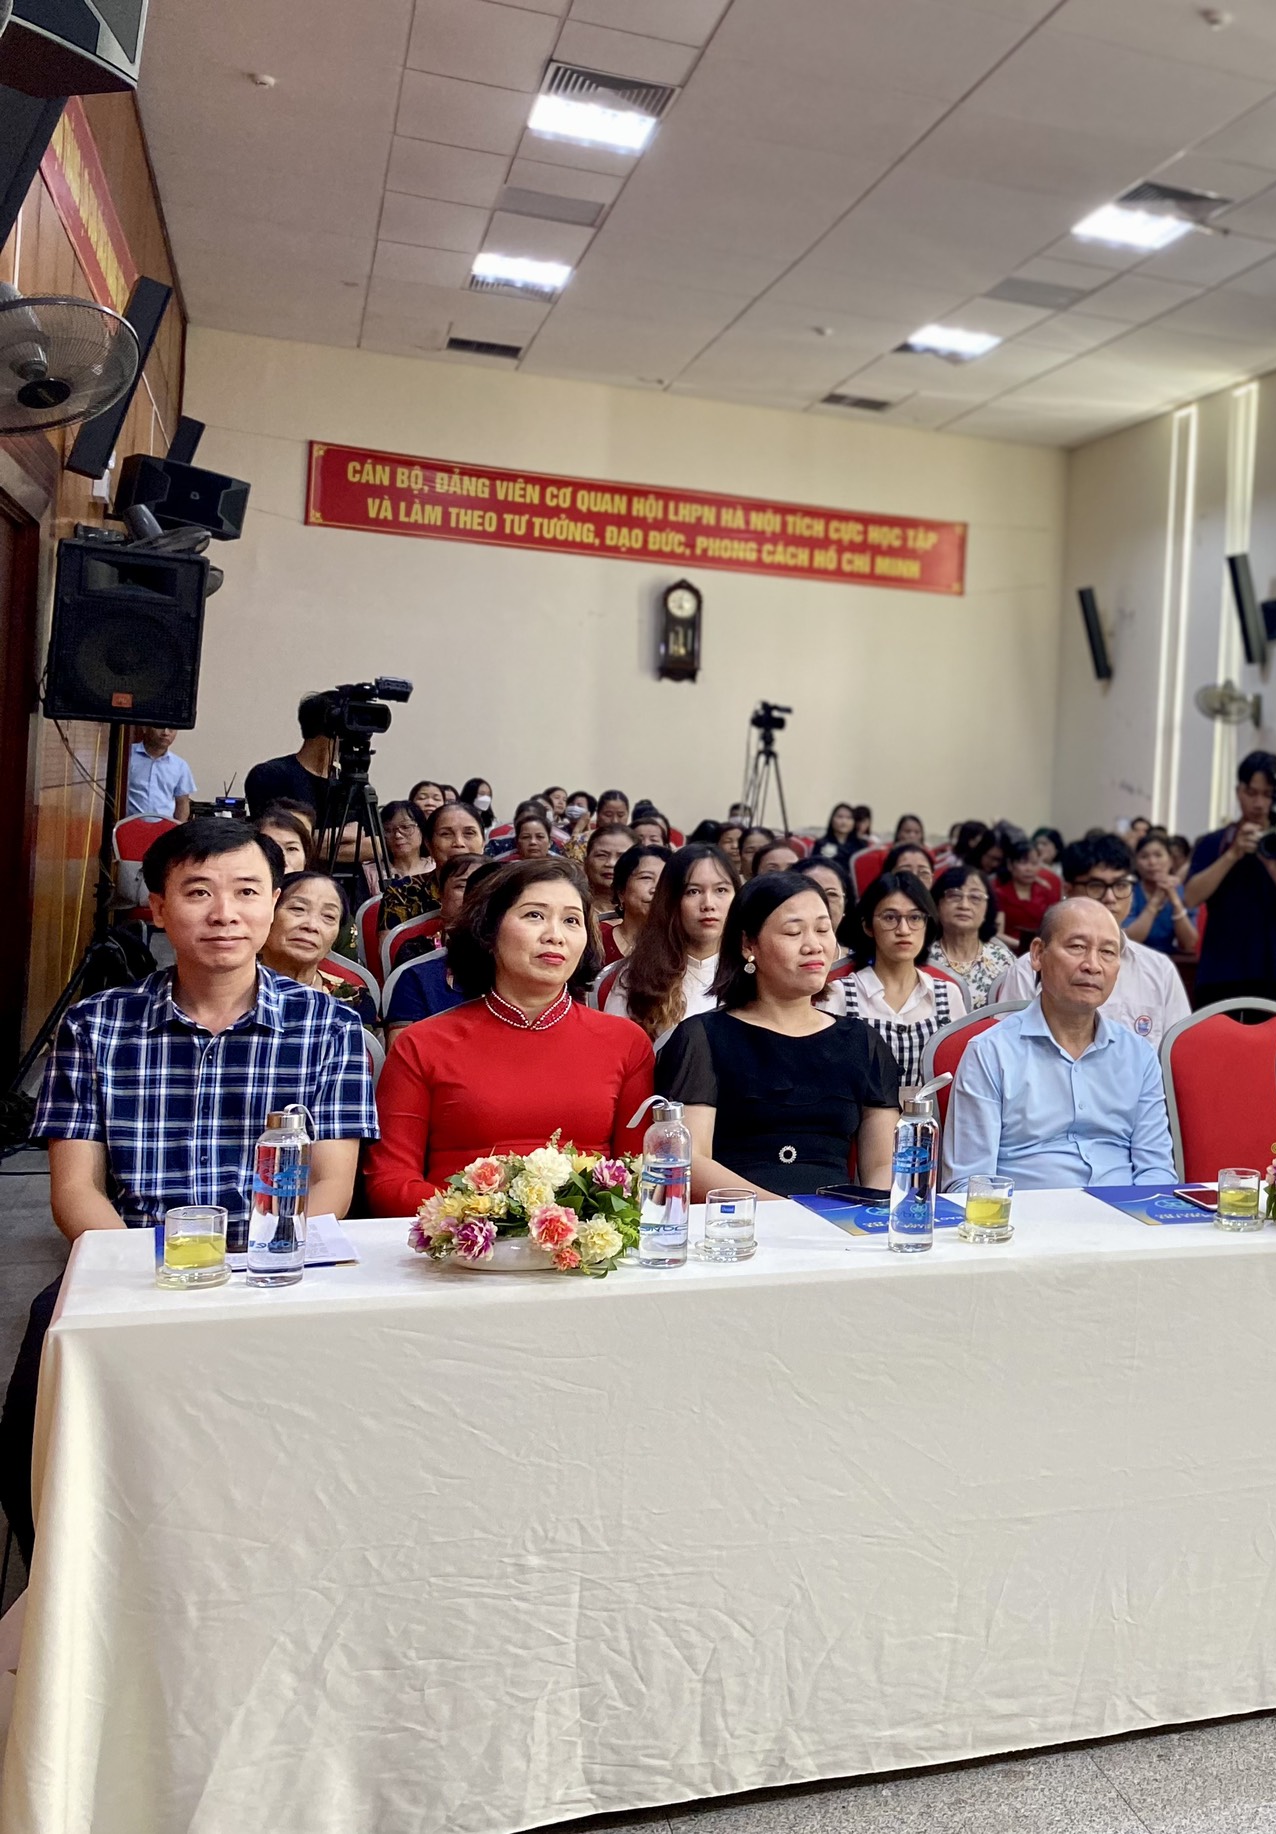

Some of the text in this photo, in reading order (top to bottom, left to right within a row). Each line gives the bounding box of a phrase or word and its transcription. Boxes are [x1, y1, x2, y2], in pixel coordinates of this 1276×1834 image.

[347, 459, 390, 486] CÁN
[396, 465, 429, 494] BỘ,
[435, 468, 490, 498] ĐẢNG
[495, 478, 540, 505] VIÊN
[545, 486, 573, 508] CƠ
[576, 489, 627, 515] QUAN
[632, 494, 664, 522] HỘI
[668, 500, 716, 527] LHPN
[721, 504, 746, 530] HÀ
[749, 508, 782, 537] NỘI
[785, 512, 825, 538] TÍCH
[828, 519, 864, 545] CỰC
[867, 523, 903, 550] HỌC
[367, 495, 393, 521] VÀ
[398, 498, 442, 526] LÀM
[448, 506, 498, 533] THEO
[503, 513, 529, 536] TƯ
[532, 514, 600, 546] TƯỞNG,
[605, 526, 643, 552] ĐẠO
[648, 528, 691, 556] ĐỨC,
[695, 536, 758, 563] PHONG
[761, 541, 810, 569] CÁCH
[841, 550, 871, 575] CHÍ
[875, 554, 921, 580] MINH
